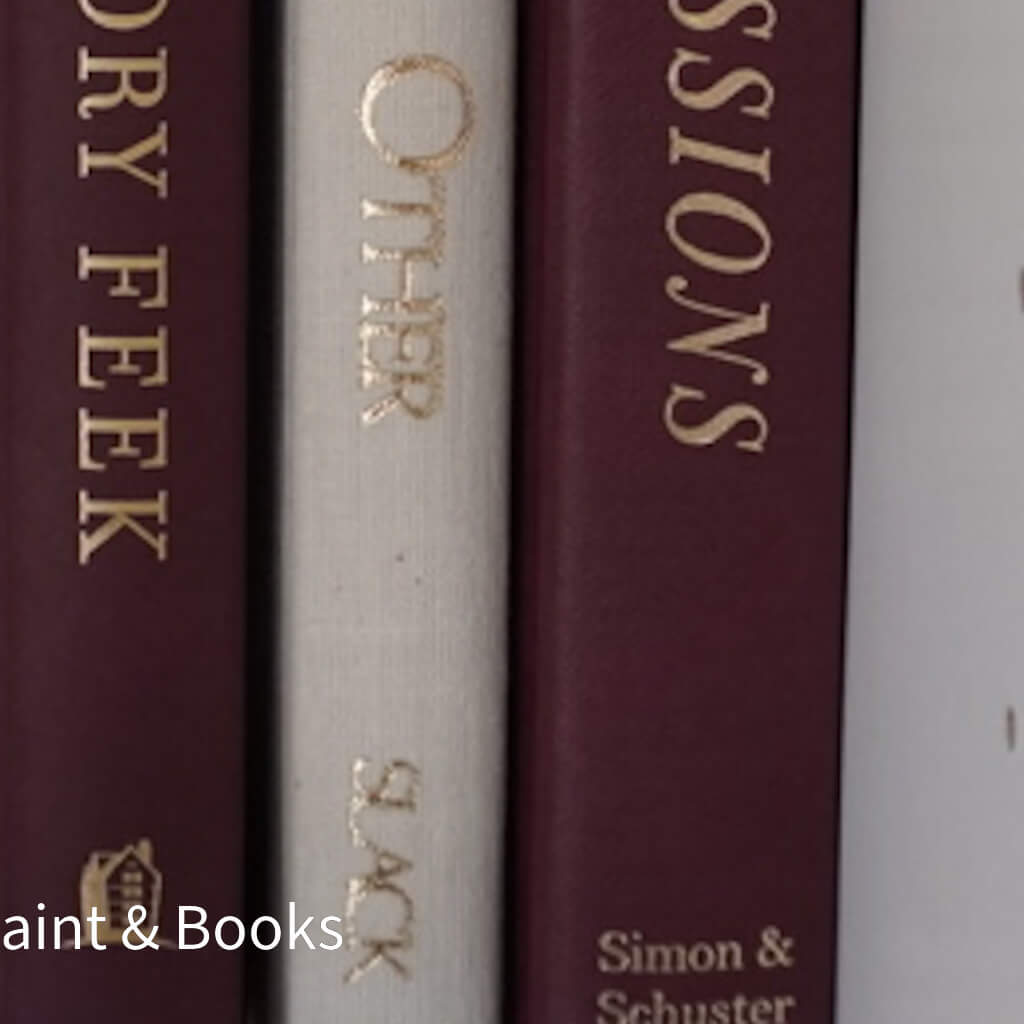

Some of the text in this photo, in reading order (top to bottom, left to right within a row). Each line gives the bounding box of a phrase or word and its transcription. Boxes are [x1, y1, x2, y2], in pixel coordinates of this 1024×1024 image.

[357, 53, 474, 427] OTHER
[77, 246, 169, 565] FEEK
[343, 758, 420, 984] SLACK
[597, 925, 795, 974] Simon &
[596, 989, 796, 1024] Schuster
